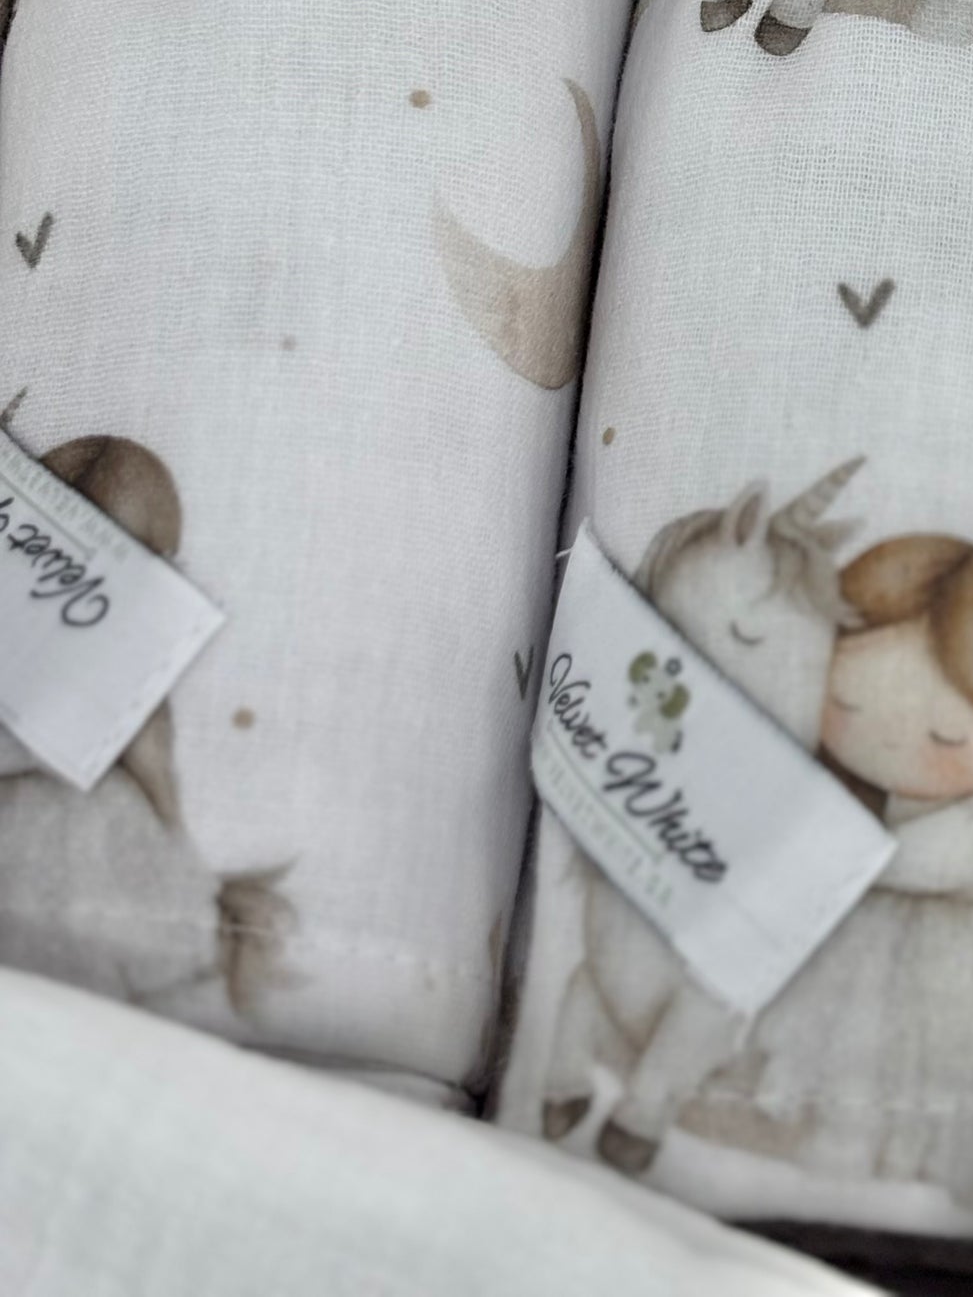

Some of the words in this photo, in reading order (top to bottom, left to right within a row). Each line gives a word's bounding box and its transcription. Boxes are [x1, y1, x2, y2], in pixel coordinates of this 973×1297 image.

[7, 523, 109, 627] Velvet
[547, 652, 607, 760] Velvet
[603, 752, 727, 884] White
